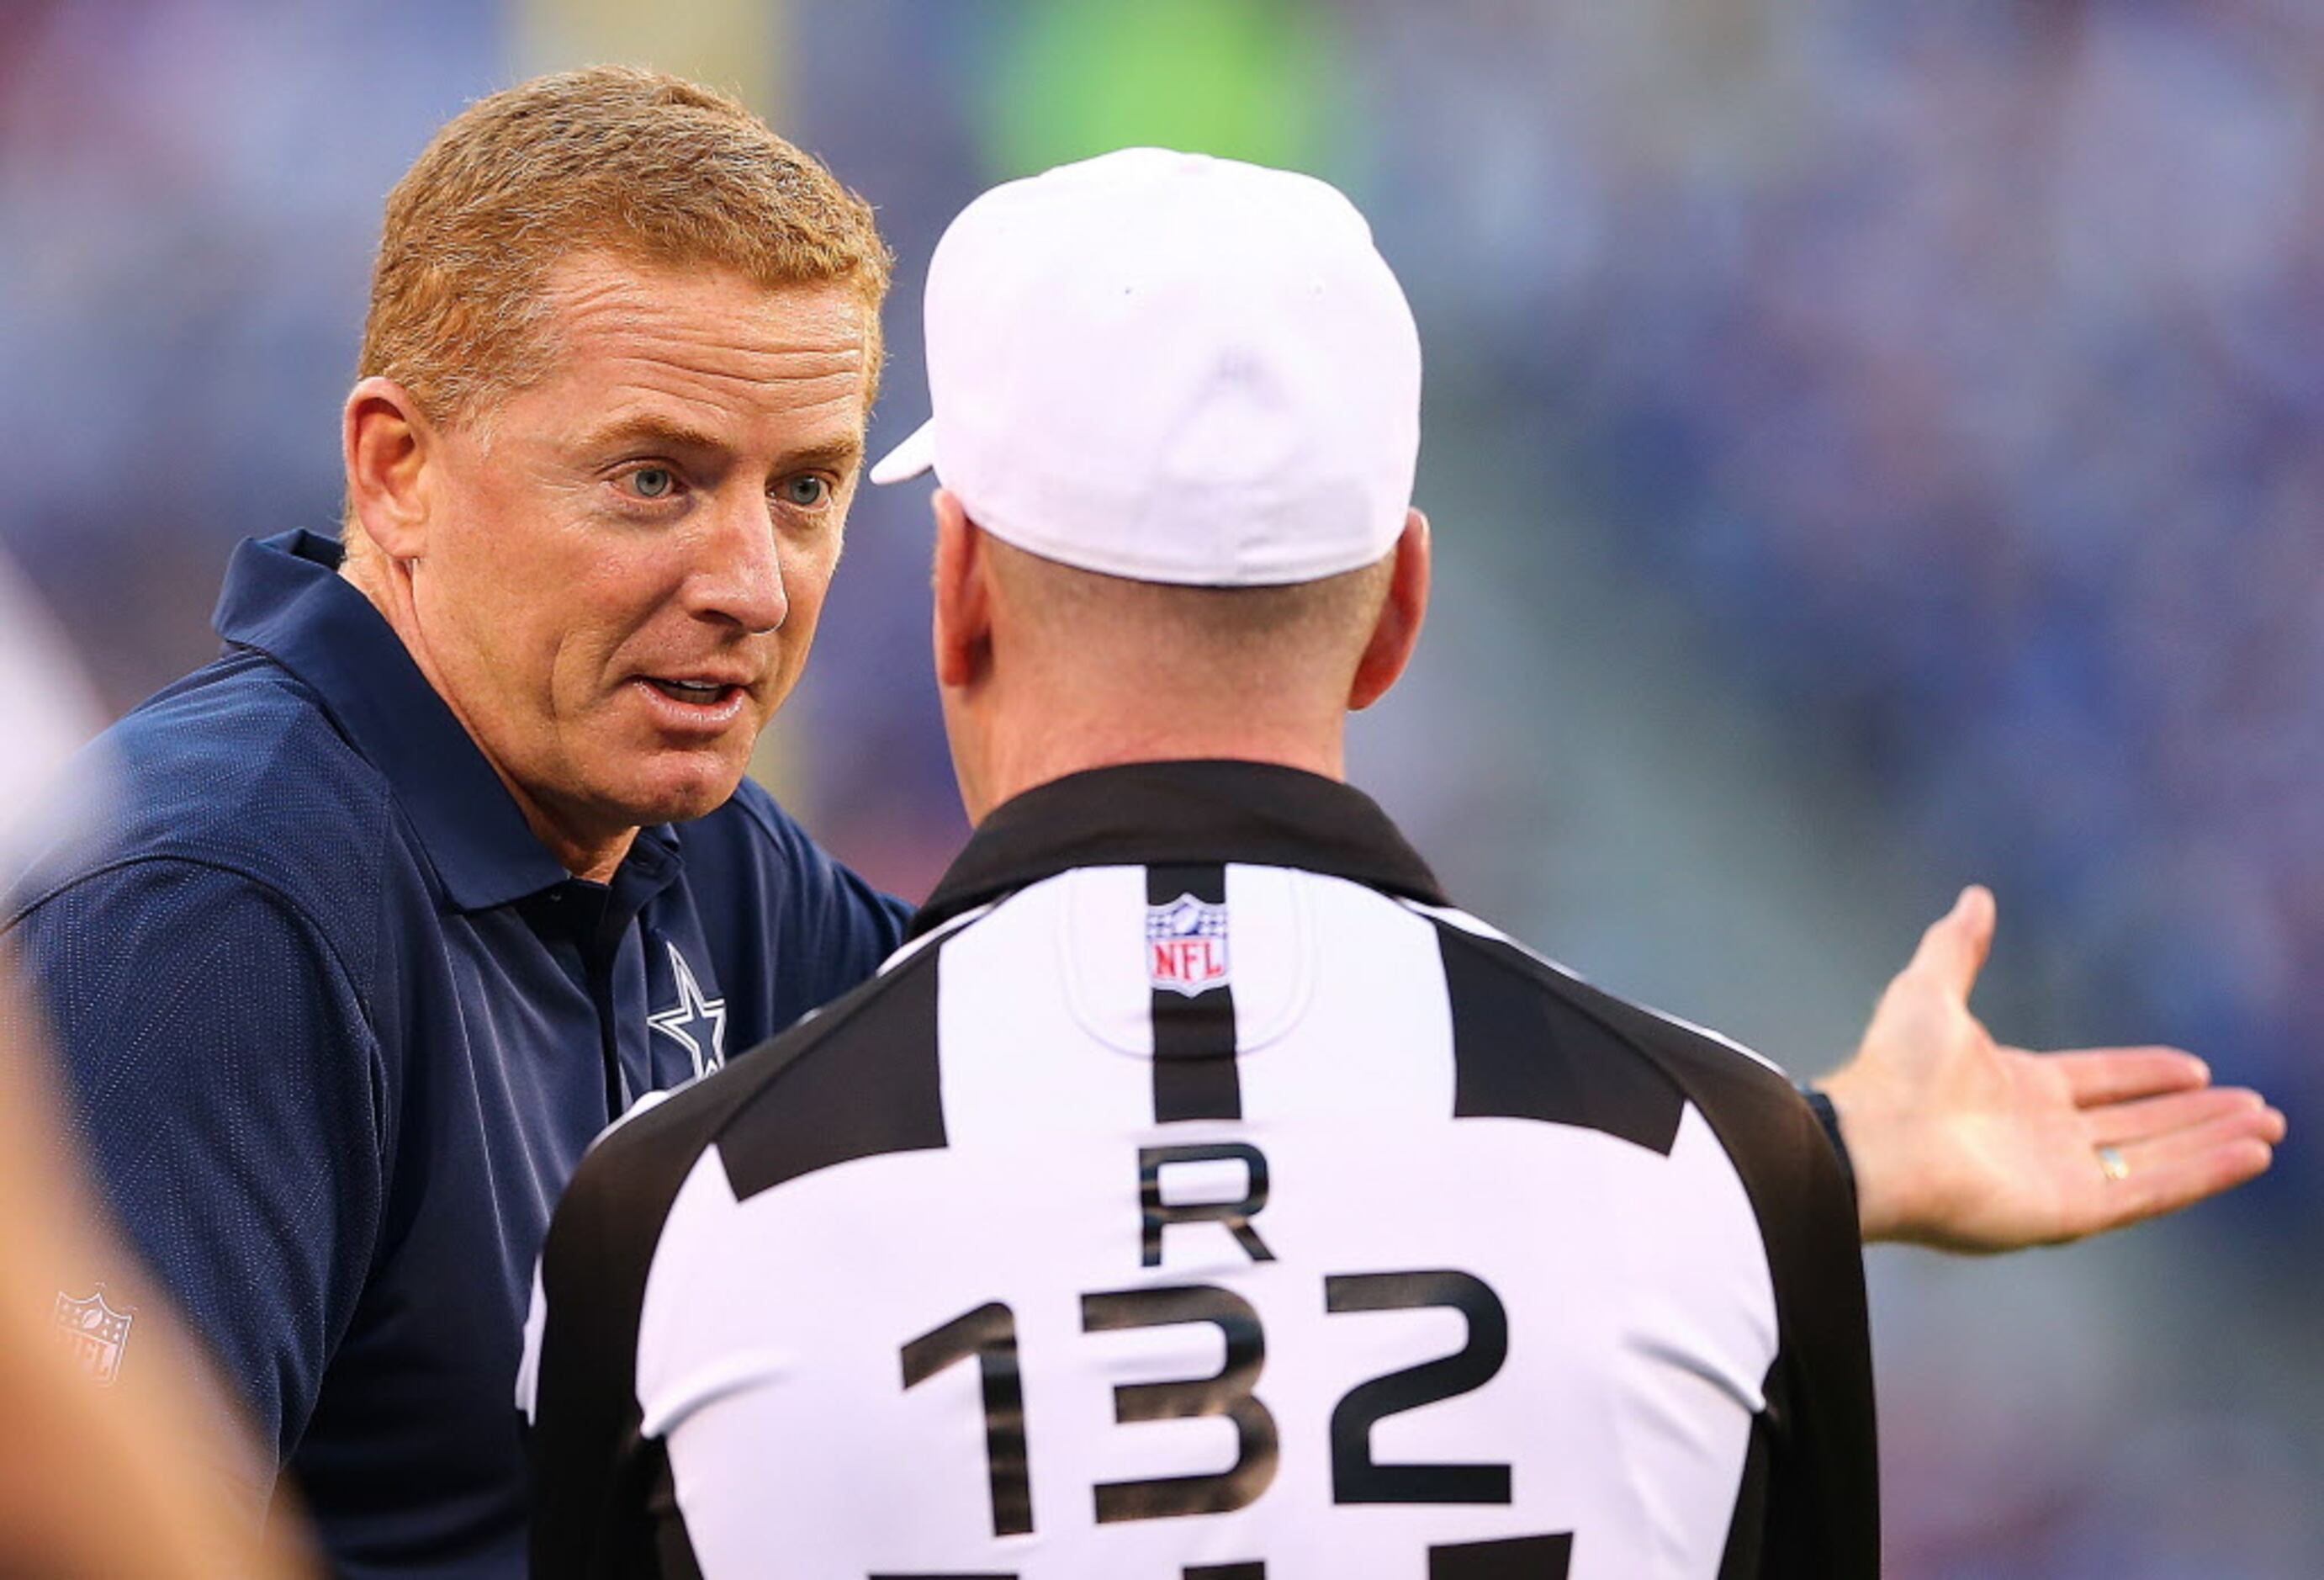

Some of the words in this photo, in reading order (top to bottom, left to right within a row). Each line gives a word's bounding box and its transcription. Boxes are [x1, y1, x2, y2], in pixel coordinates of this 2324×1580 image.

[1152, 941, 1225, 981] NFL
[1138, 1142, 1277, 1268] R
[899, 1269, 1513, 1538] 132
